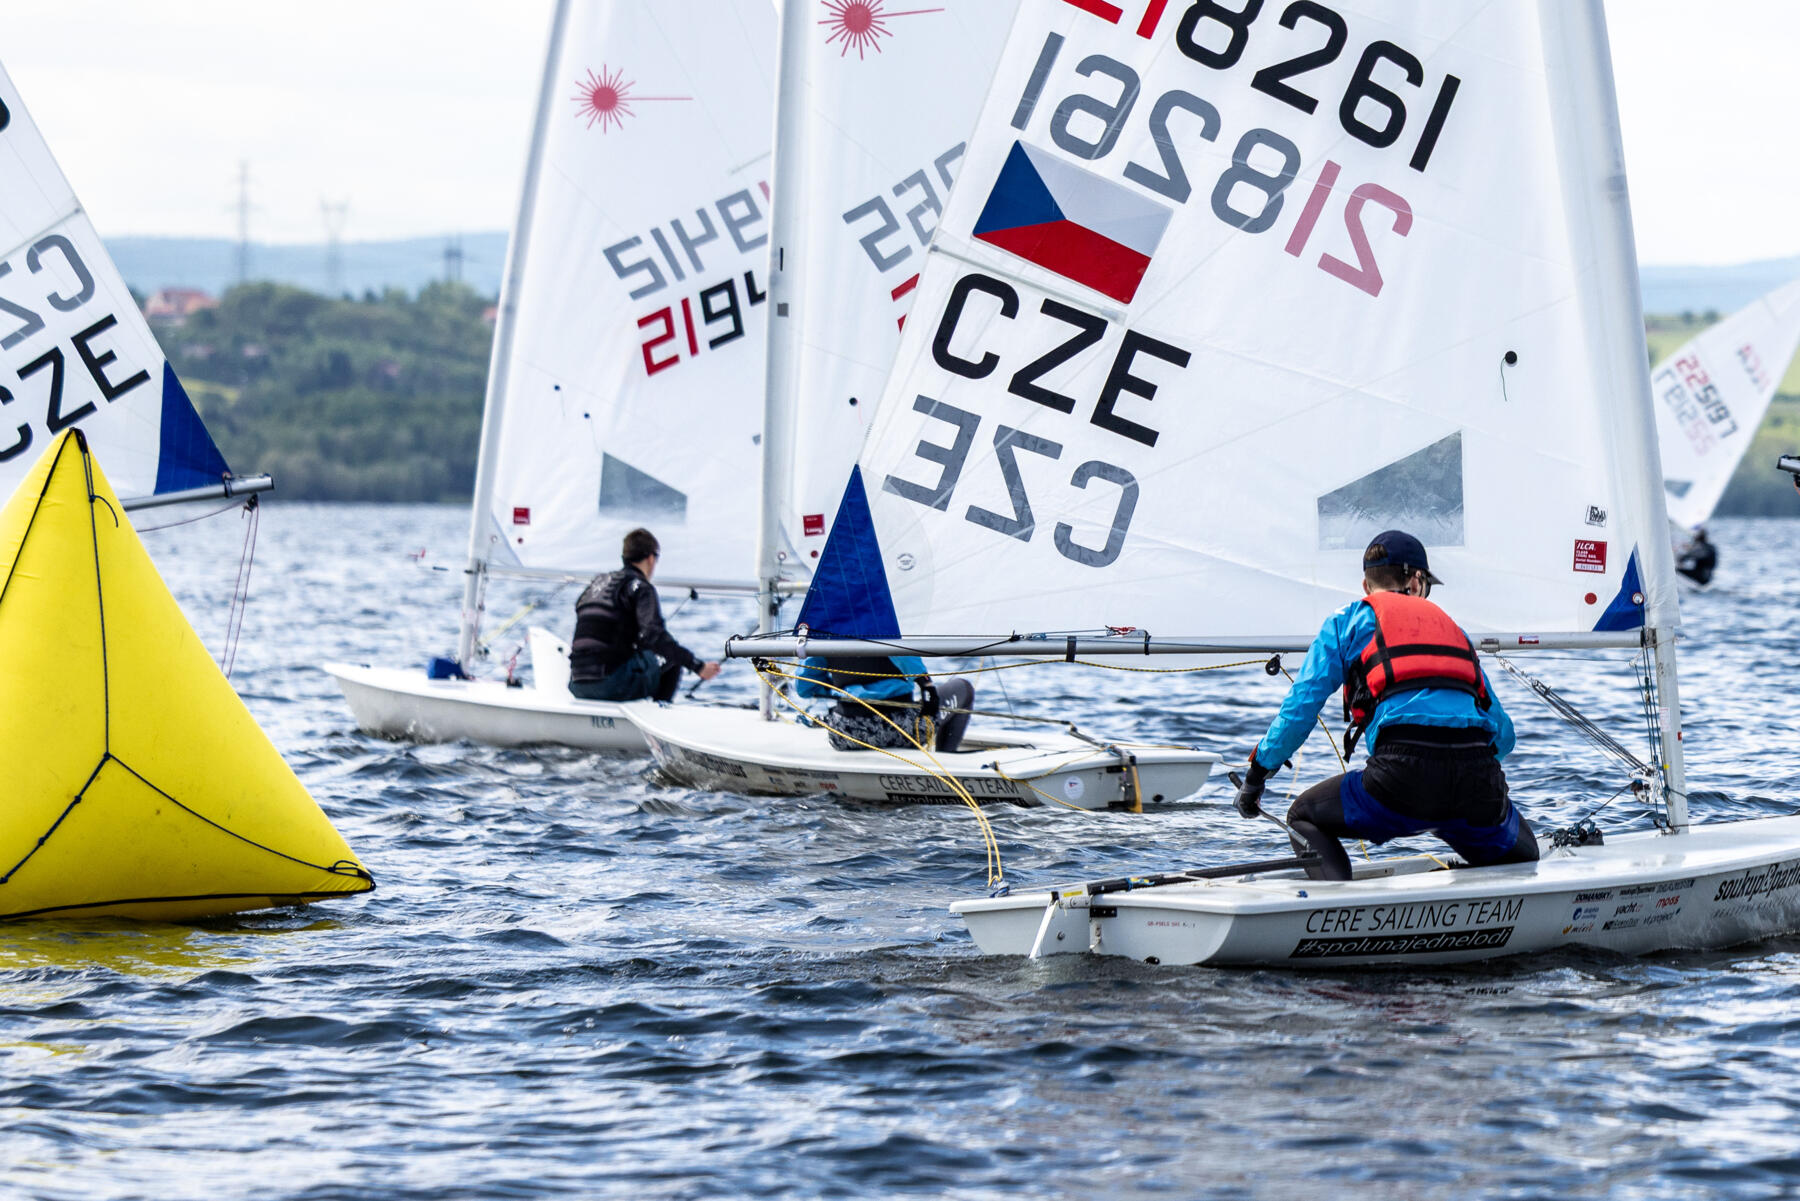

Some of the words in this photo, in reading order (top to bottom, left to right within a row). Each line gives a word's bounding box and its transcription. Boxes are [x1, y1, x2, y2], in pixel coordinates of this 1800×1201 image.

[1063, 0, 1461, 172] 8261
[932, 273, 1192, 448] CZE
[1675, 354, 1739, 439] 225197
[1577, 542, 1595, 551] ILCA
[880, 775, 915, 792] CERE
[976, 778, 1020, 795] TEAM
[1306, 908, 1366, 933] CERE
[1368, 903, 1460, 931] SAILING
[1465, 898, 1524, 926] TEAM
[1301, 927, 1511, 957] #spolunajednelodi
